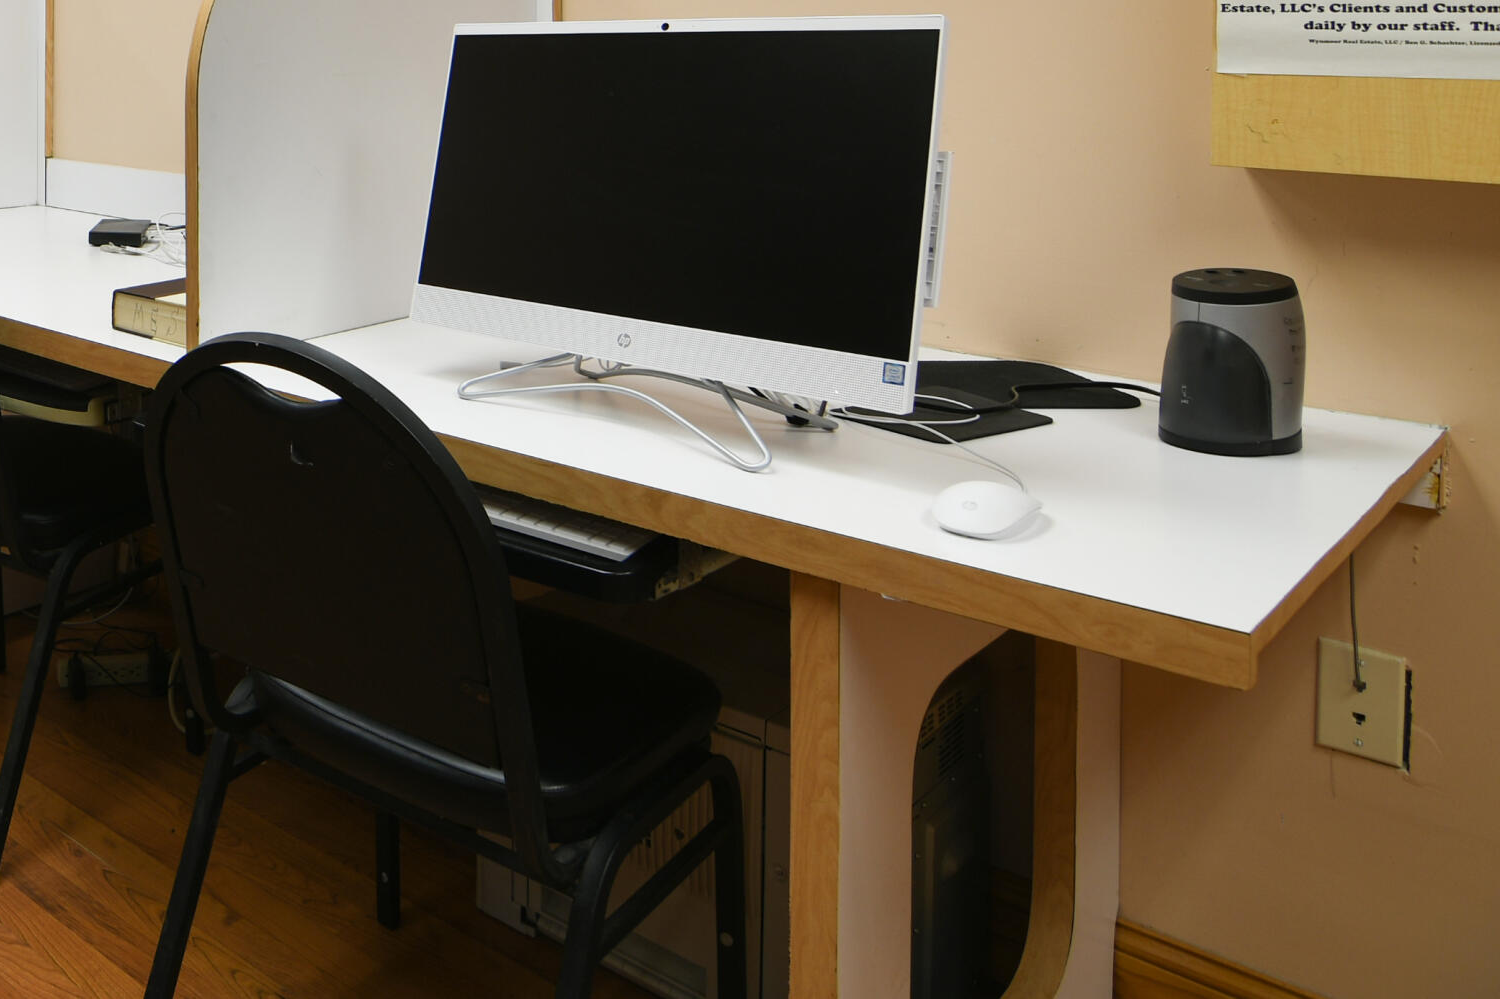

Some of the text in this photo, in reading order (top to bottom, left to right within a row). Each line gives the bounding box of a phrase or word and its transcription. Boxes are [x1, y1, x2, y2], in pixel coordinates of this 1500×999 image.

[1220, 3, 1276, 15] Estate,
[1280, 3, 1326, 13] LLC's
[1329, 3, 1391, 13] Clients
[1395, 3, 1428, 13] and
[1304, 21, 1346, 32] daily
[1351, 21, 1372, 32] by
[1413, 21, 1460, 31] staff.
